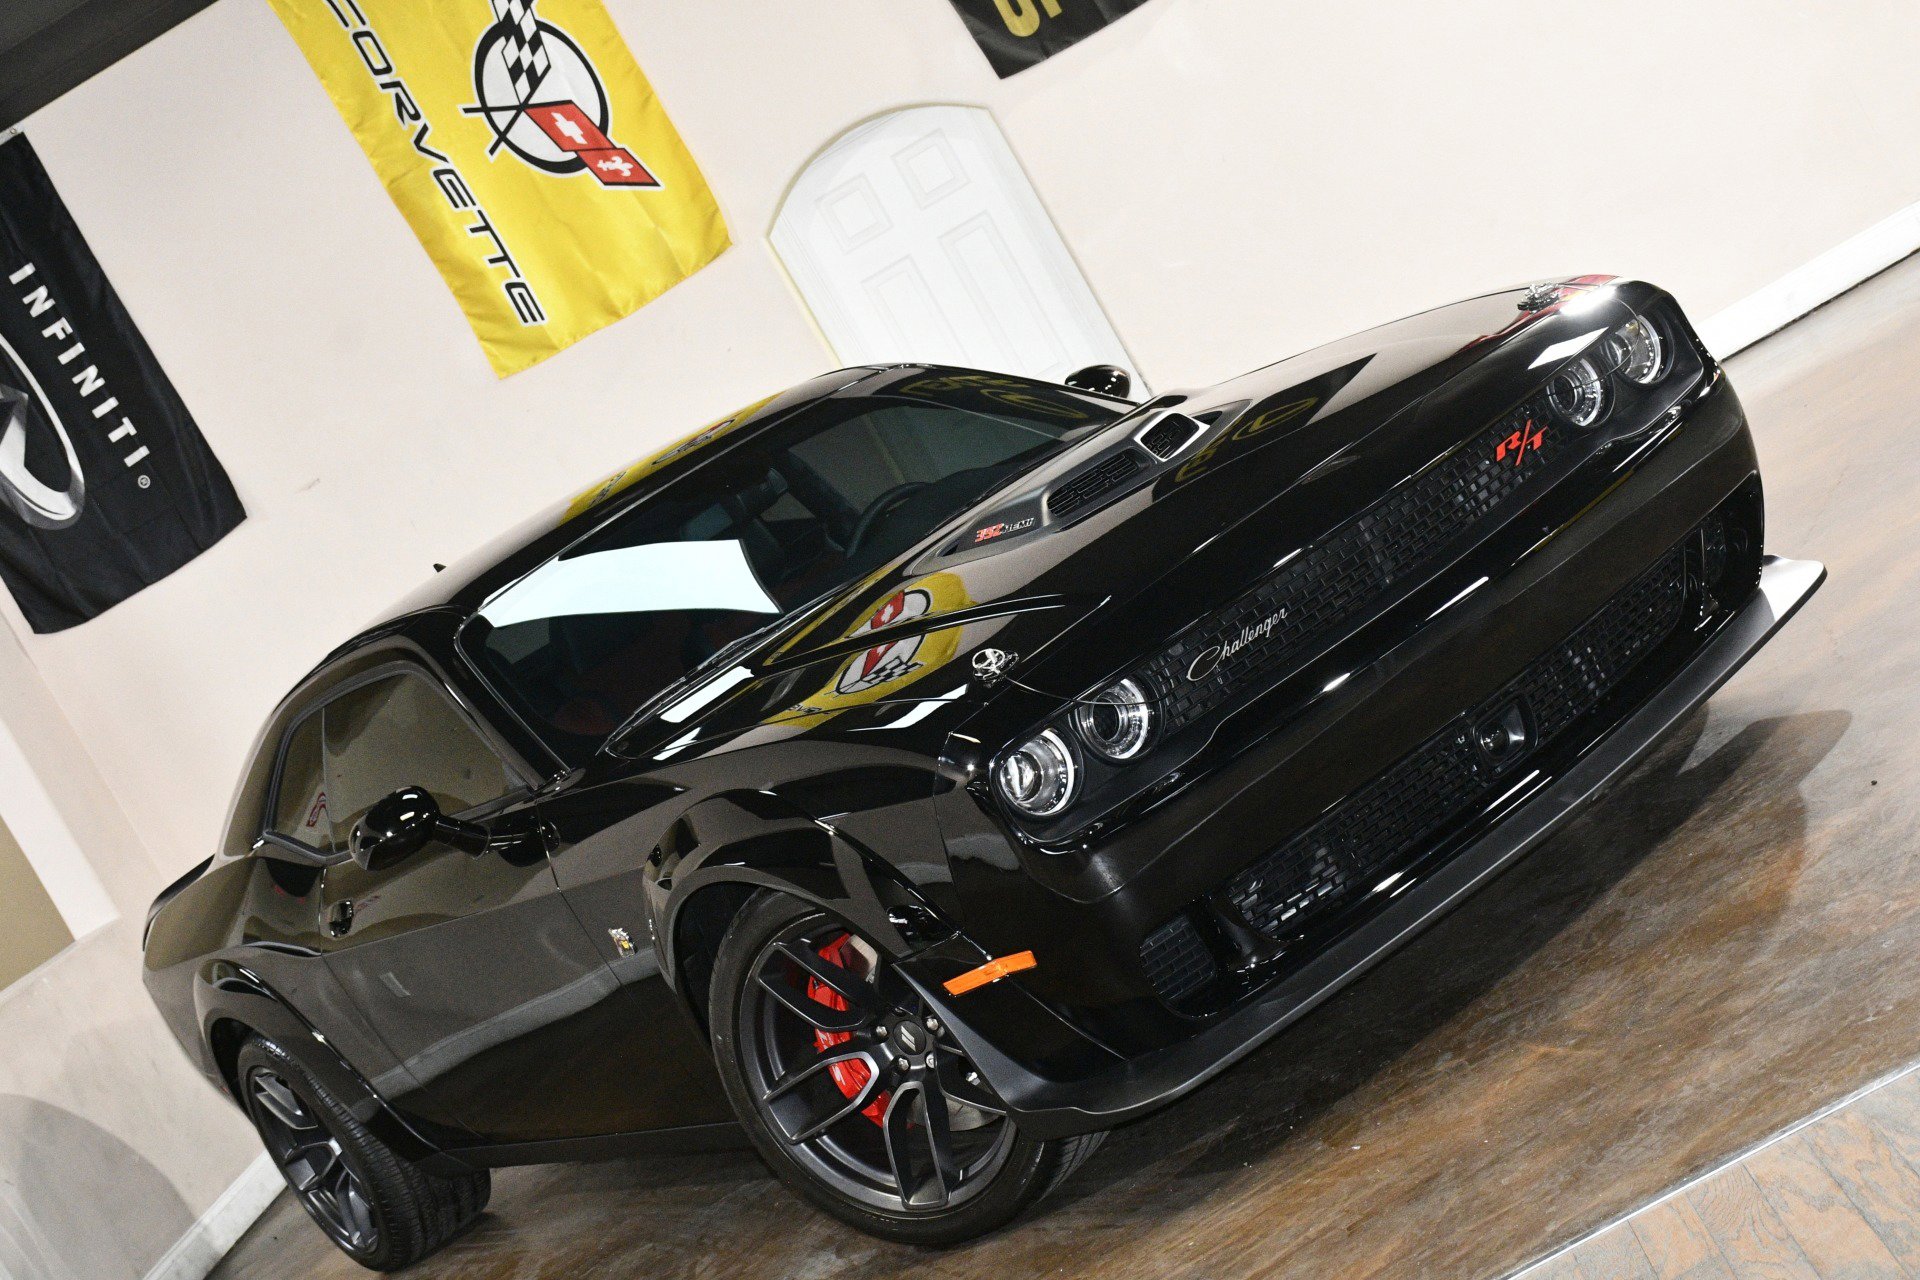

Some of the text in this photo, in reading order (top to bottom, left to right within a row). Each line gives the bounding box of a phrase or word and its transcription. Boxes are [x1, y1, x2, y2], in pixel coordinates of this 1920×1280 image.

[9, 262, 150, 467] INFINITI
[1496, 419, 1548, 466] R/T
[1186, 608, 1288, 682] Challenger
